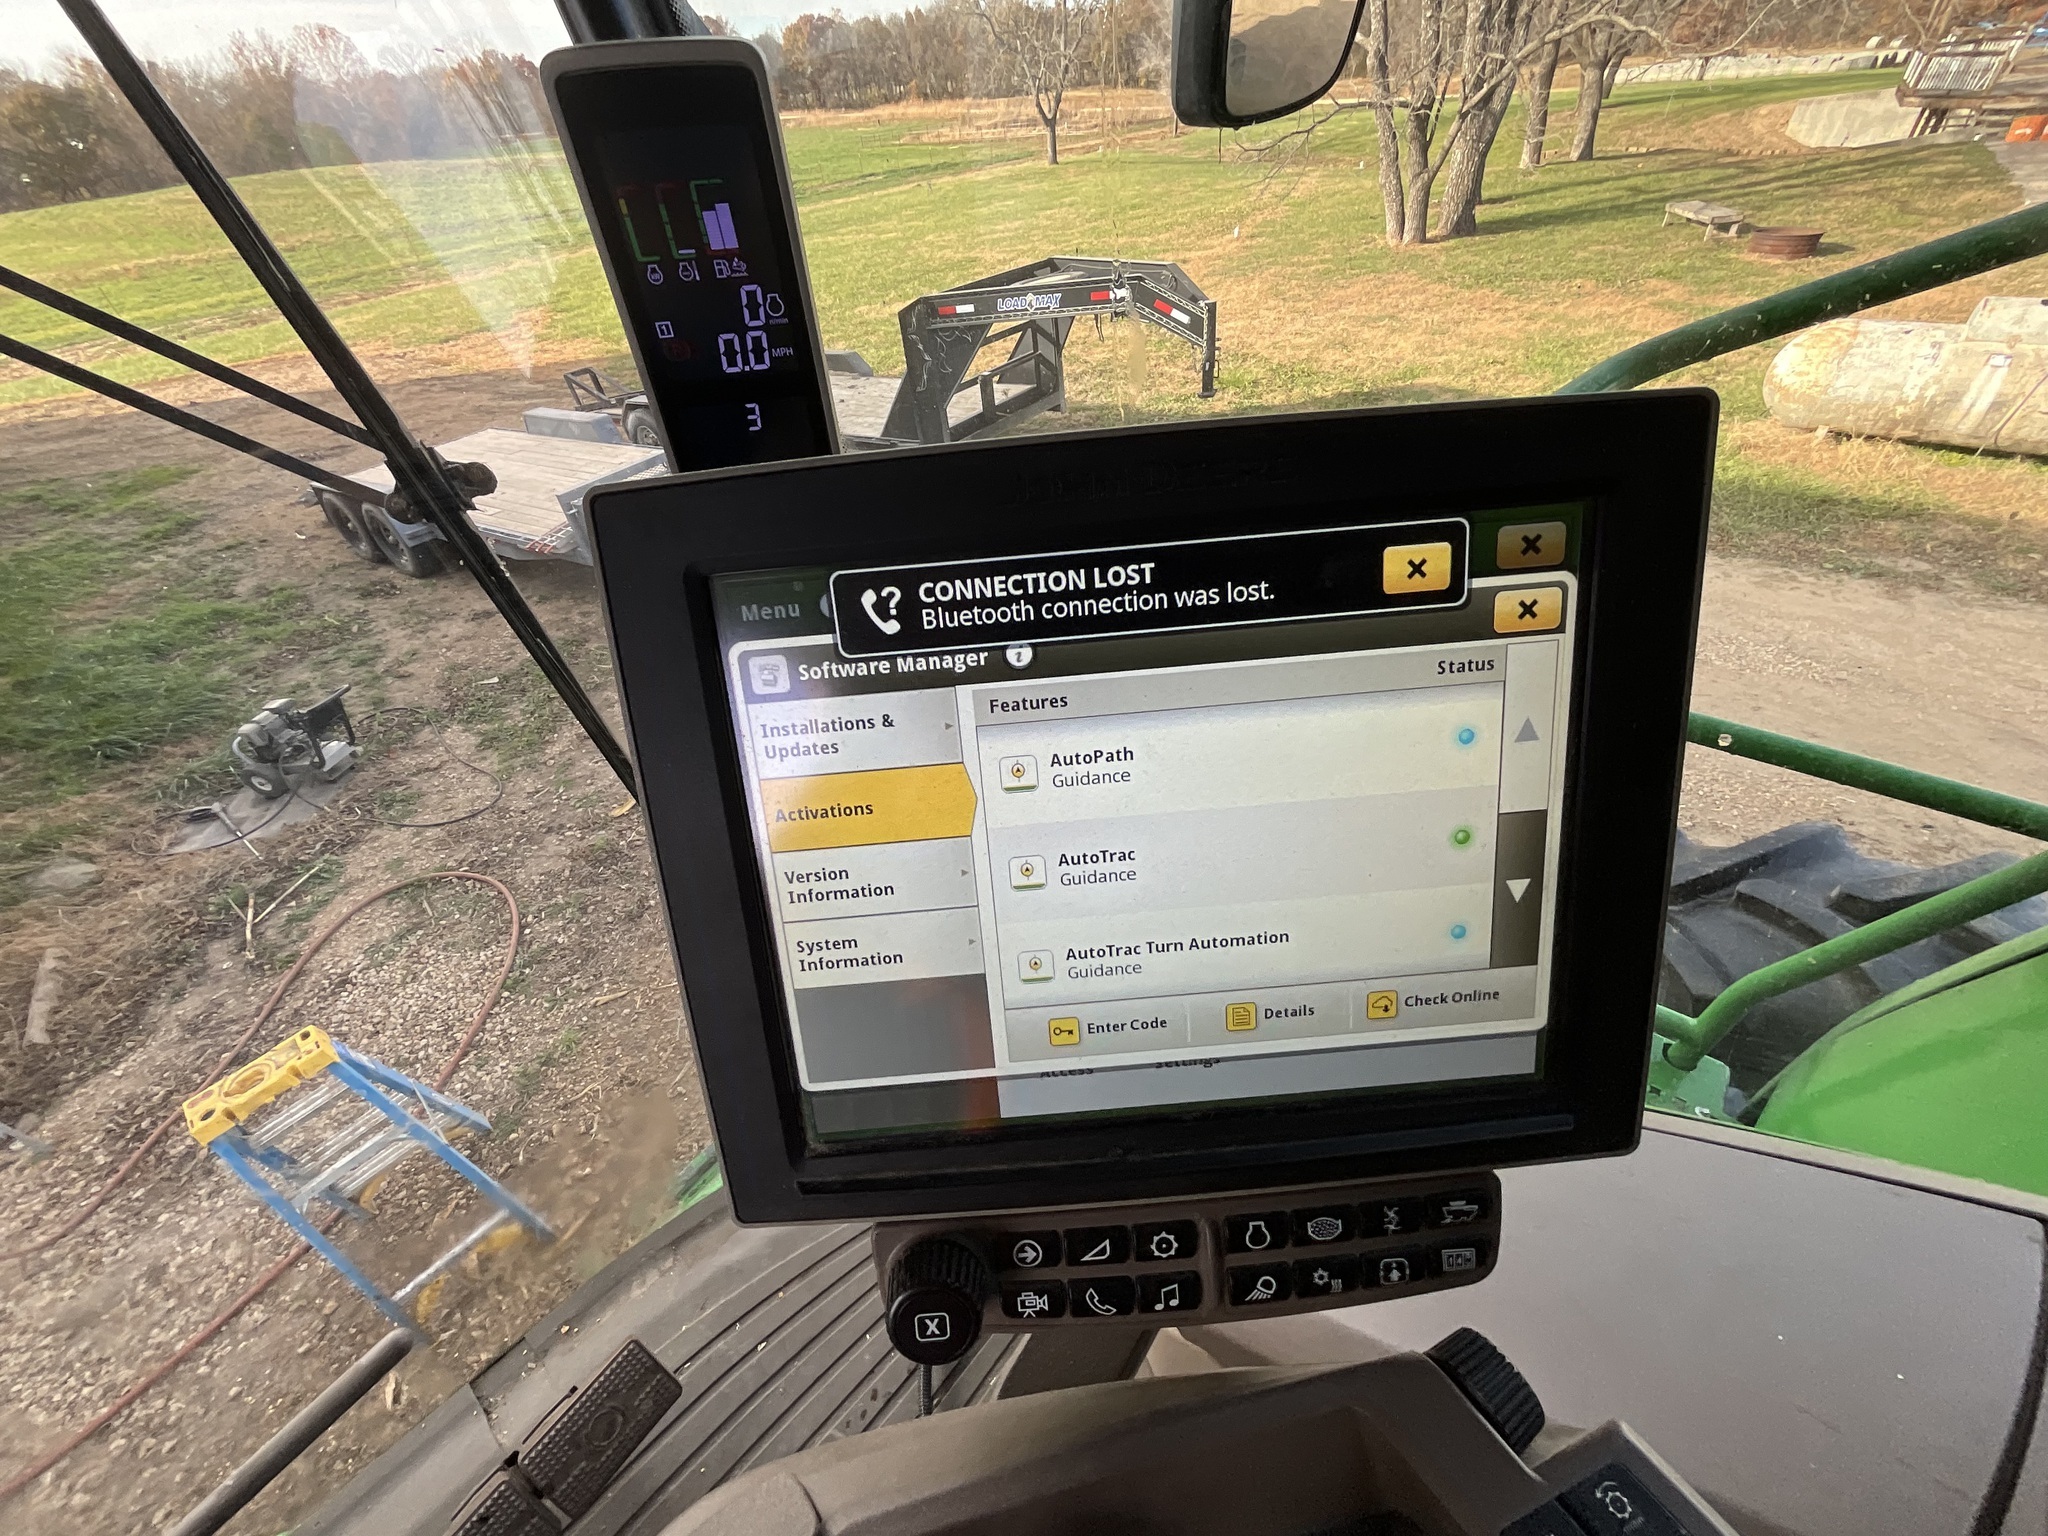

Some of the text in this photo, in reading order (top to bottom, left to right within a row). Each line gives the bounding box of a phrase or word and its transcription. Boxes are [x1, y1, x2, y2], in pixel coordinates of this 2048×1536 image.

[997, 293, 1062, 311] LOAD MAX
[718, 330, 794, 373] 0.0 MPH
[919, 562, 1155, 603] CONNECTION LOST
[741, 602, 800, 621] Menu
[922, 580, 1275, 630] Bluetooth connection was lost.
[798, 657, 890, 681] Software
[897, 651, 989, 674] Manager
[1437, 658, 1495, 675] Status
[989, 694, 1068, 714] Features
[760, 713, 895, 739] Installations &
[764, 740, 839, 762] Updates
[1050, 746, 1135, 768] AutoPath
[1052, 769, 1132, 788] Guidance
[775, 801, 874, 823] Activations
[1058, 849, 1136, 868] AutoTrac
[784, 867, 850, 885] Version
[1060, 868, 1138, 887] Guidance
[787, 882, 895, 905] Information
[796, 937, 859, 958] System
[1065, 929, 1290, 961] AutoTrac Turn Automation
[799, 951, 903, 972] Information
[1067, 963, 1142, 979] Guidance
[1404, 987, 1500, 1007] Check Online
[1264, 1004, 1315, 1019] Details
[1087, 1017, 1168, 1035] Enter Code
